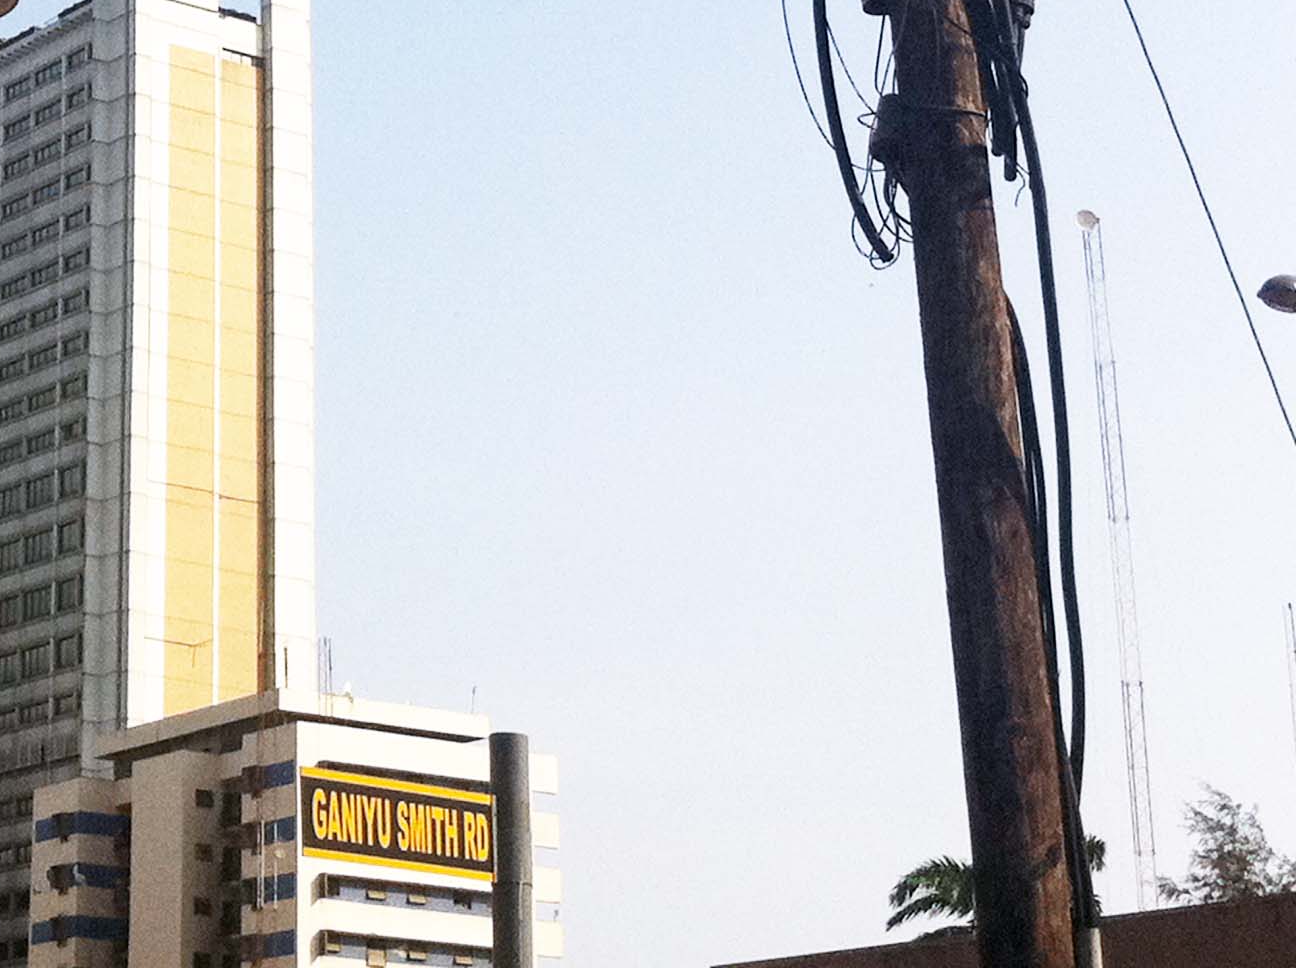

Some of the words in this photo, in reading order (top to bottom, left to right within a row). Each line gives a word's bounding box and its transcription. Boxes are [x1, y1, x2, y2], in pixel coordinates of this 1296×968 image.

[311, 788, 391, 849] GANIYU
[396, 800, 459, 858] SMITH
[463, 810, 489, 862] RD
